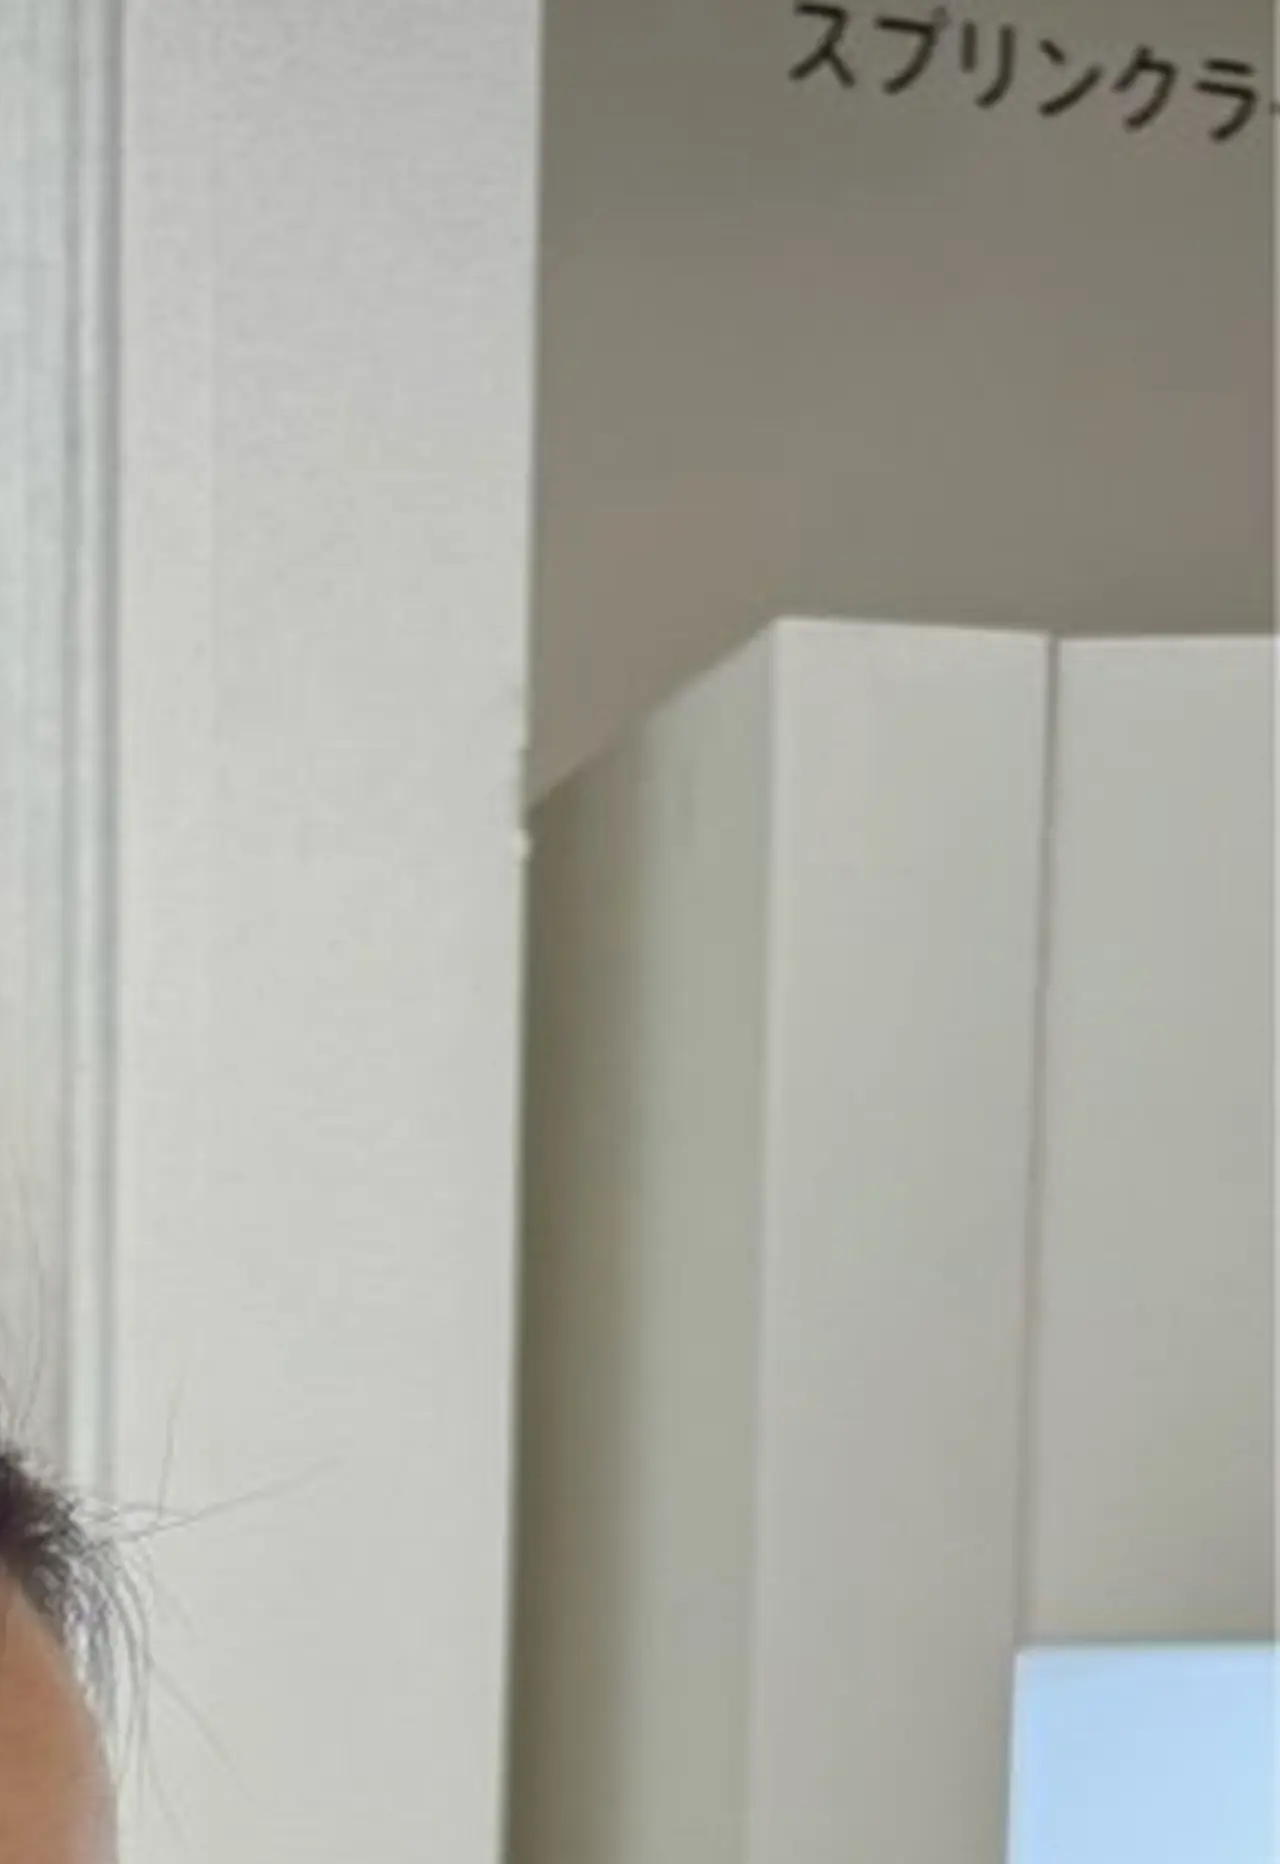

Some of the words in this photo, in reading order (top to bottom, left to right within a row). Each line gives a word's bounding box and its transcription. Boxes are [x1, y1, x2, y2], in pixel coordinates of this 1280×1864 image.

[788, 2, 1280, 142] スプリンクラ
